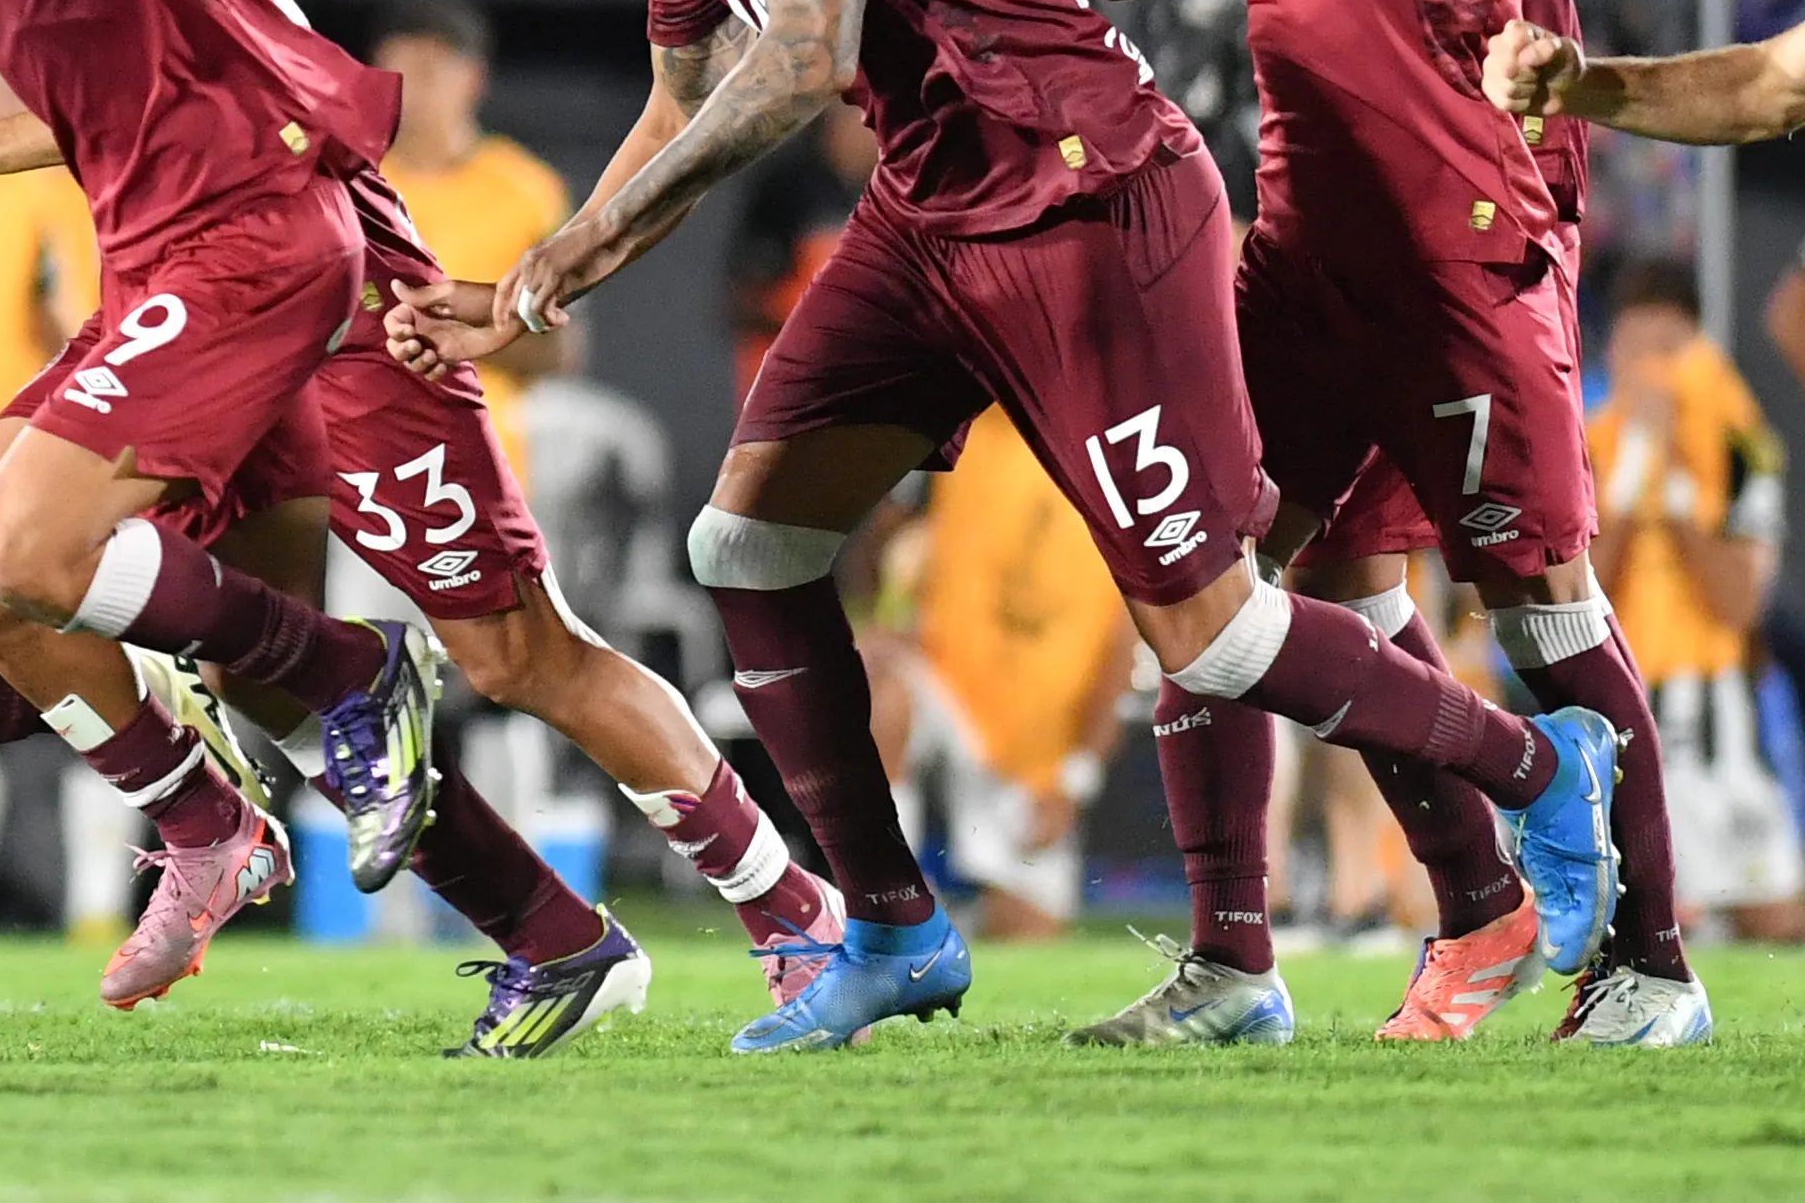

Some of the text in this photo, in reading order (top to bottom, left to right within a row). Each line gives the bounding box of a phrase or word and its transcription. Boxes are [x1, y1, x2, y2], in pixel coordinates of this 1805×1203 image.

[103, 292, 188, 366] 9
[1432, 393, 1492, 495] 7
[1085, 404, 1190, 529] 13
[335, 442, 476, 551] 33
[1159, 530, 1207, 565] umbro
[1470, 529, 1519, 547] umbro
[428, 569, 481, 591] umbro
[864, 884, 920, 905] TIFOX
[1466, 873, 1512, 902] TIFOX
[1214, 910, 1264, 925] TIFOX
